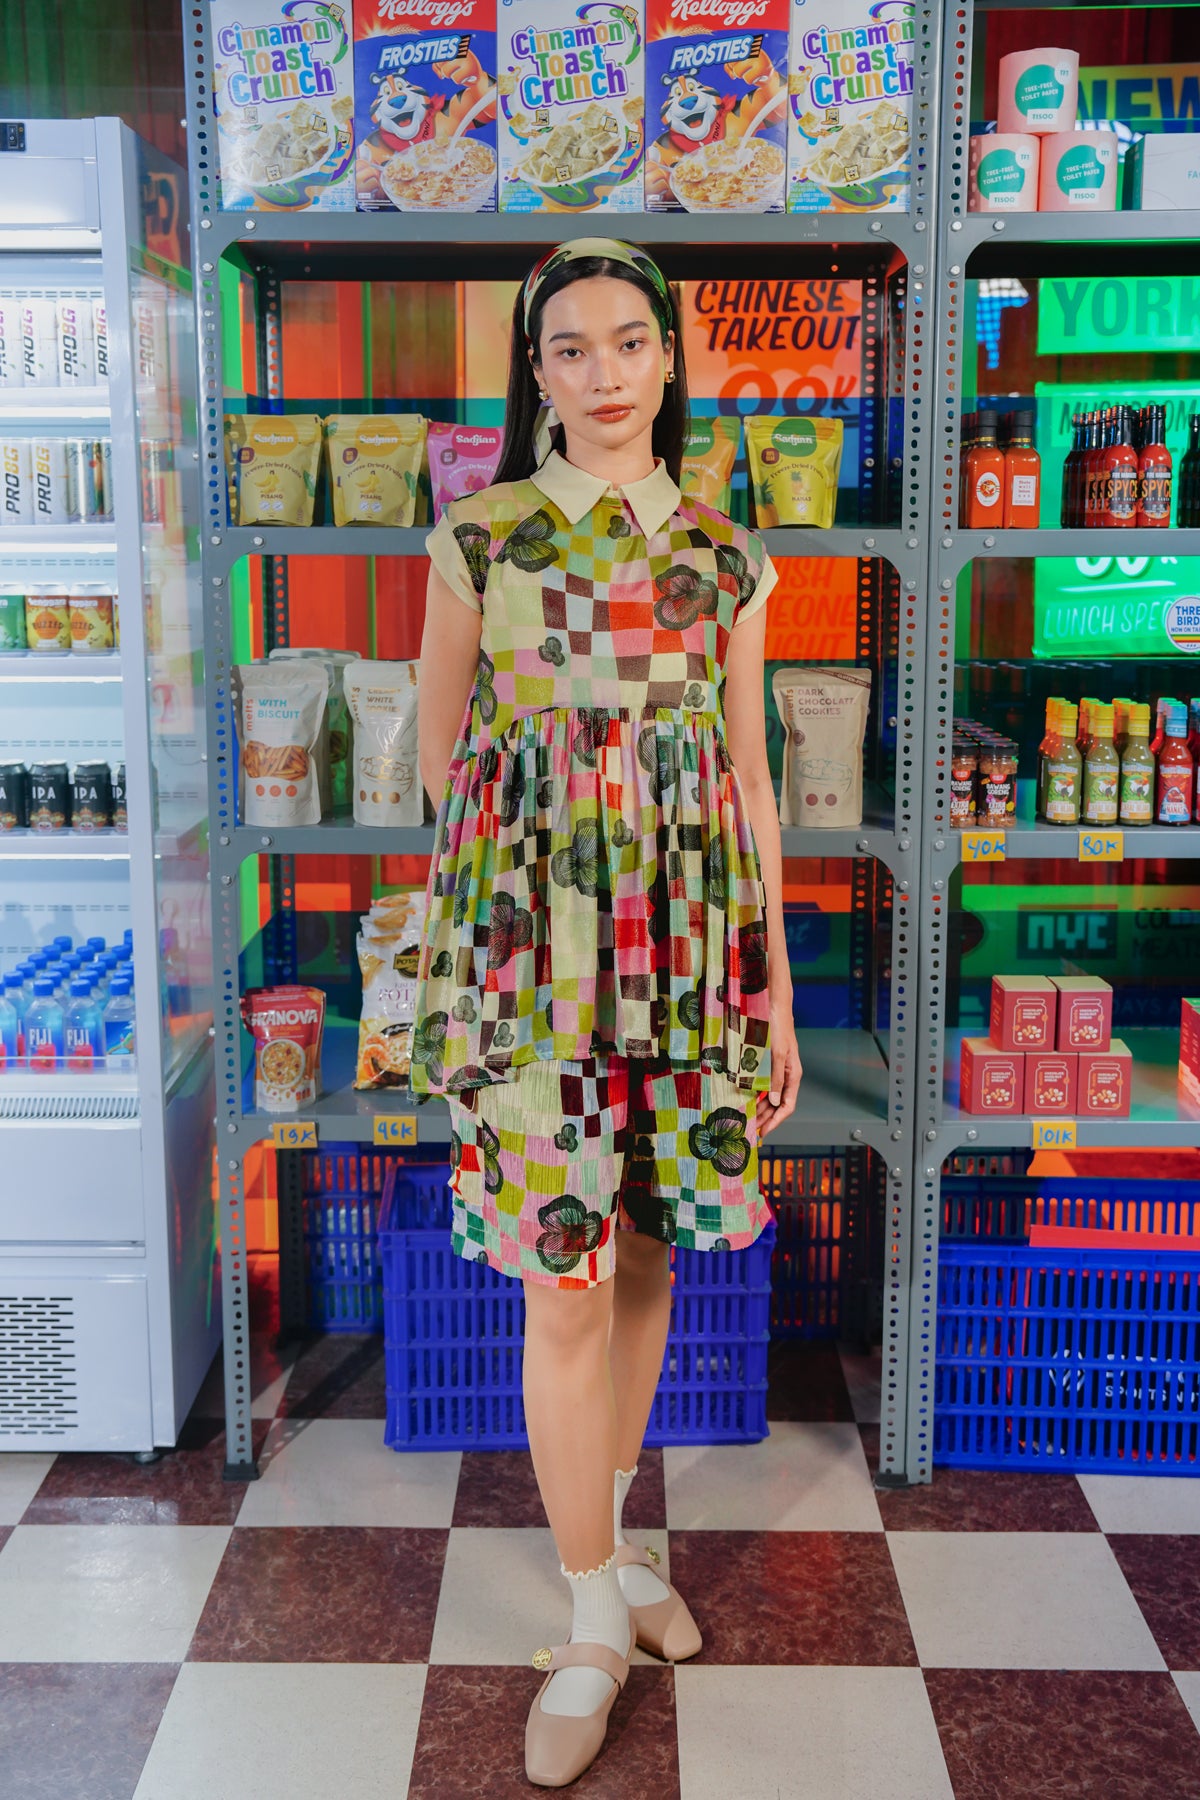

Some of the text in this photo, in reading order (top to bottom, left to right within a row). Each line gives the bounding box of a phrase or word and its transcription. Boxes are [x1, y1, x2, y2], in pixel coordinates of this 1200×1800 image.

[377, 0, 476, 25] Kellogg's
[670, 0, 768, 25] Kellogg's
[220, 19, 331, 52] Cinnamon
[515, 21, 624, 56] Cinnamon
[805, 20, 914, 56] Cinnamon
[243, 43, 313, 76] Toast
[379, 37, 459, 69] FROSTIES
[534, 45, 605, 78] Toast
[669, 38, 751, 71] FROSTIES
[826, 45, 897, 78] Toast
[229, 62, 334, 103] Crunch
[523, 64, 626, 106] Crunch
[812, 67, 914, 105] Crunch
[1021, 89, 1059, 102] TOILET PAPER
[983, 172, 1020, 185] TOILET PAPER
[1062, 168, 1100, 182] TOILET PAPER
[694, 280, 848, 314] CHINESE
[708, 315, 861, 352] TAKEOUT
[1042, 604, 1116, 639] LUNCH
[257, 698, 287, 708] WITH
[366, 696, 394, 704] WHITE
[797, 688, 824, 696] DARK
[257, 709, 301, 720] BISCUIT
[798, 707, 841, 716] COOKIES
[31, 786, 56, 799] IPA
[73, 786, 98, 799] IPA
[245, 1008, 318, 1027] GRANOVA
[29, 1028, 52, 1046] FIJI
[67, 1028, 90, 1046] FIJI
